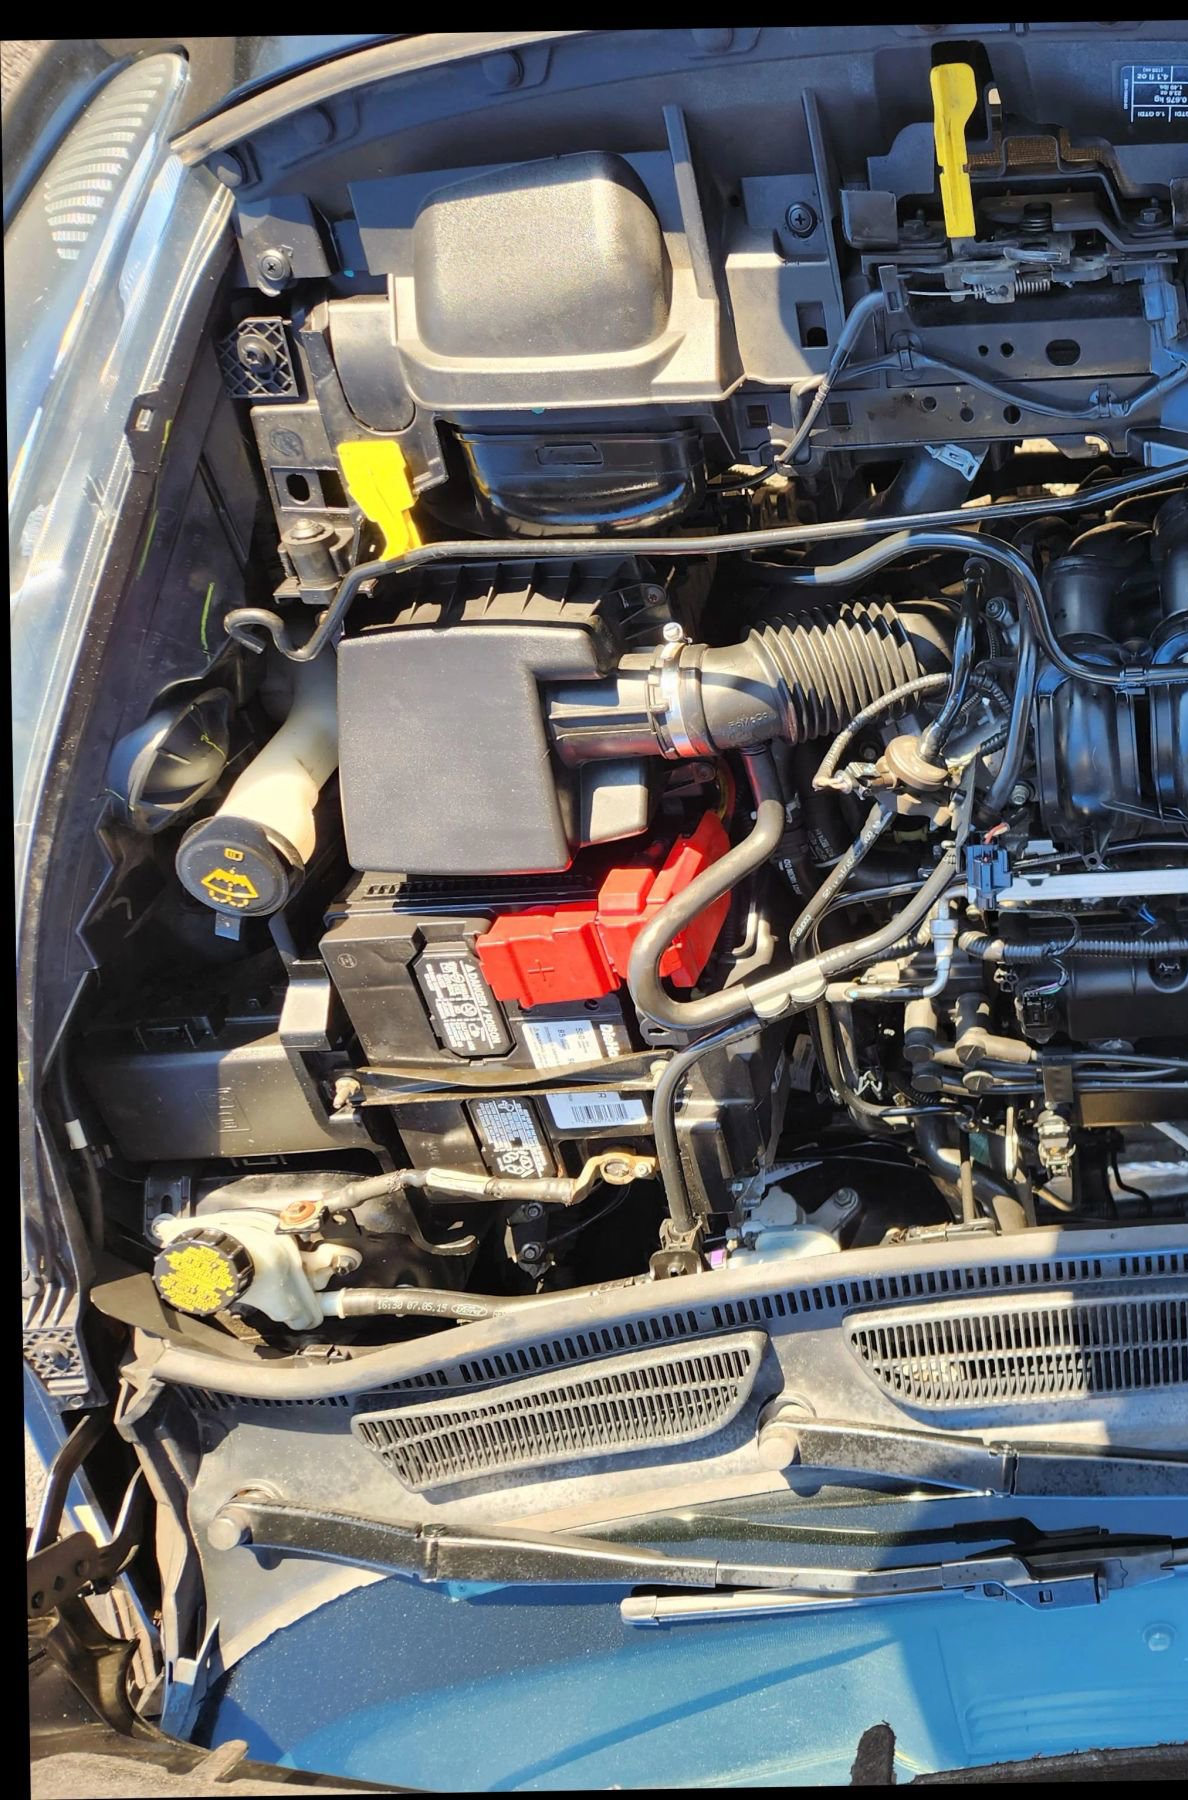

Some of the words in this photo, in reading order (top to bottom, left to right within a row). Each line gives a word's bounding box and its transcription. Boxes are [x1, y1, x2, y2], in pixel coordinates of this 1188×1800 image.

[1154, 95, 1164, 104] kg
[1166, 96, 1188, 104] 0.675
[468, 973, 488, 1010] DANGER
[482, 1014, 502, 1044] POISON
[600, 1024, 620, 1058] DieHa
